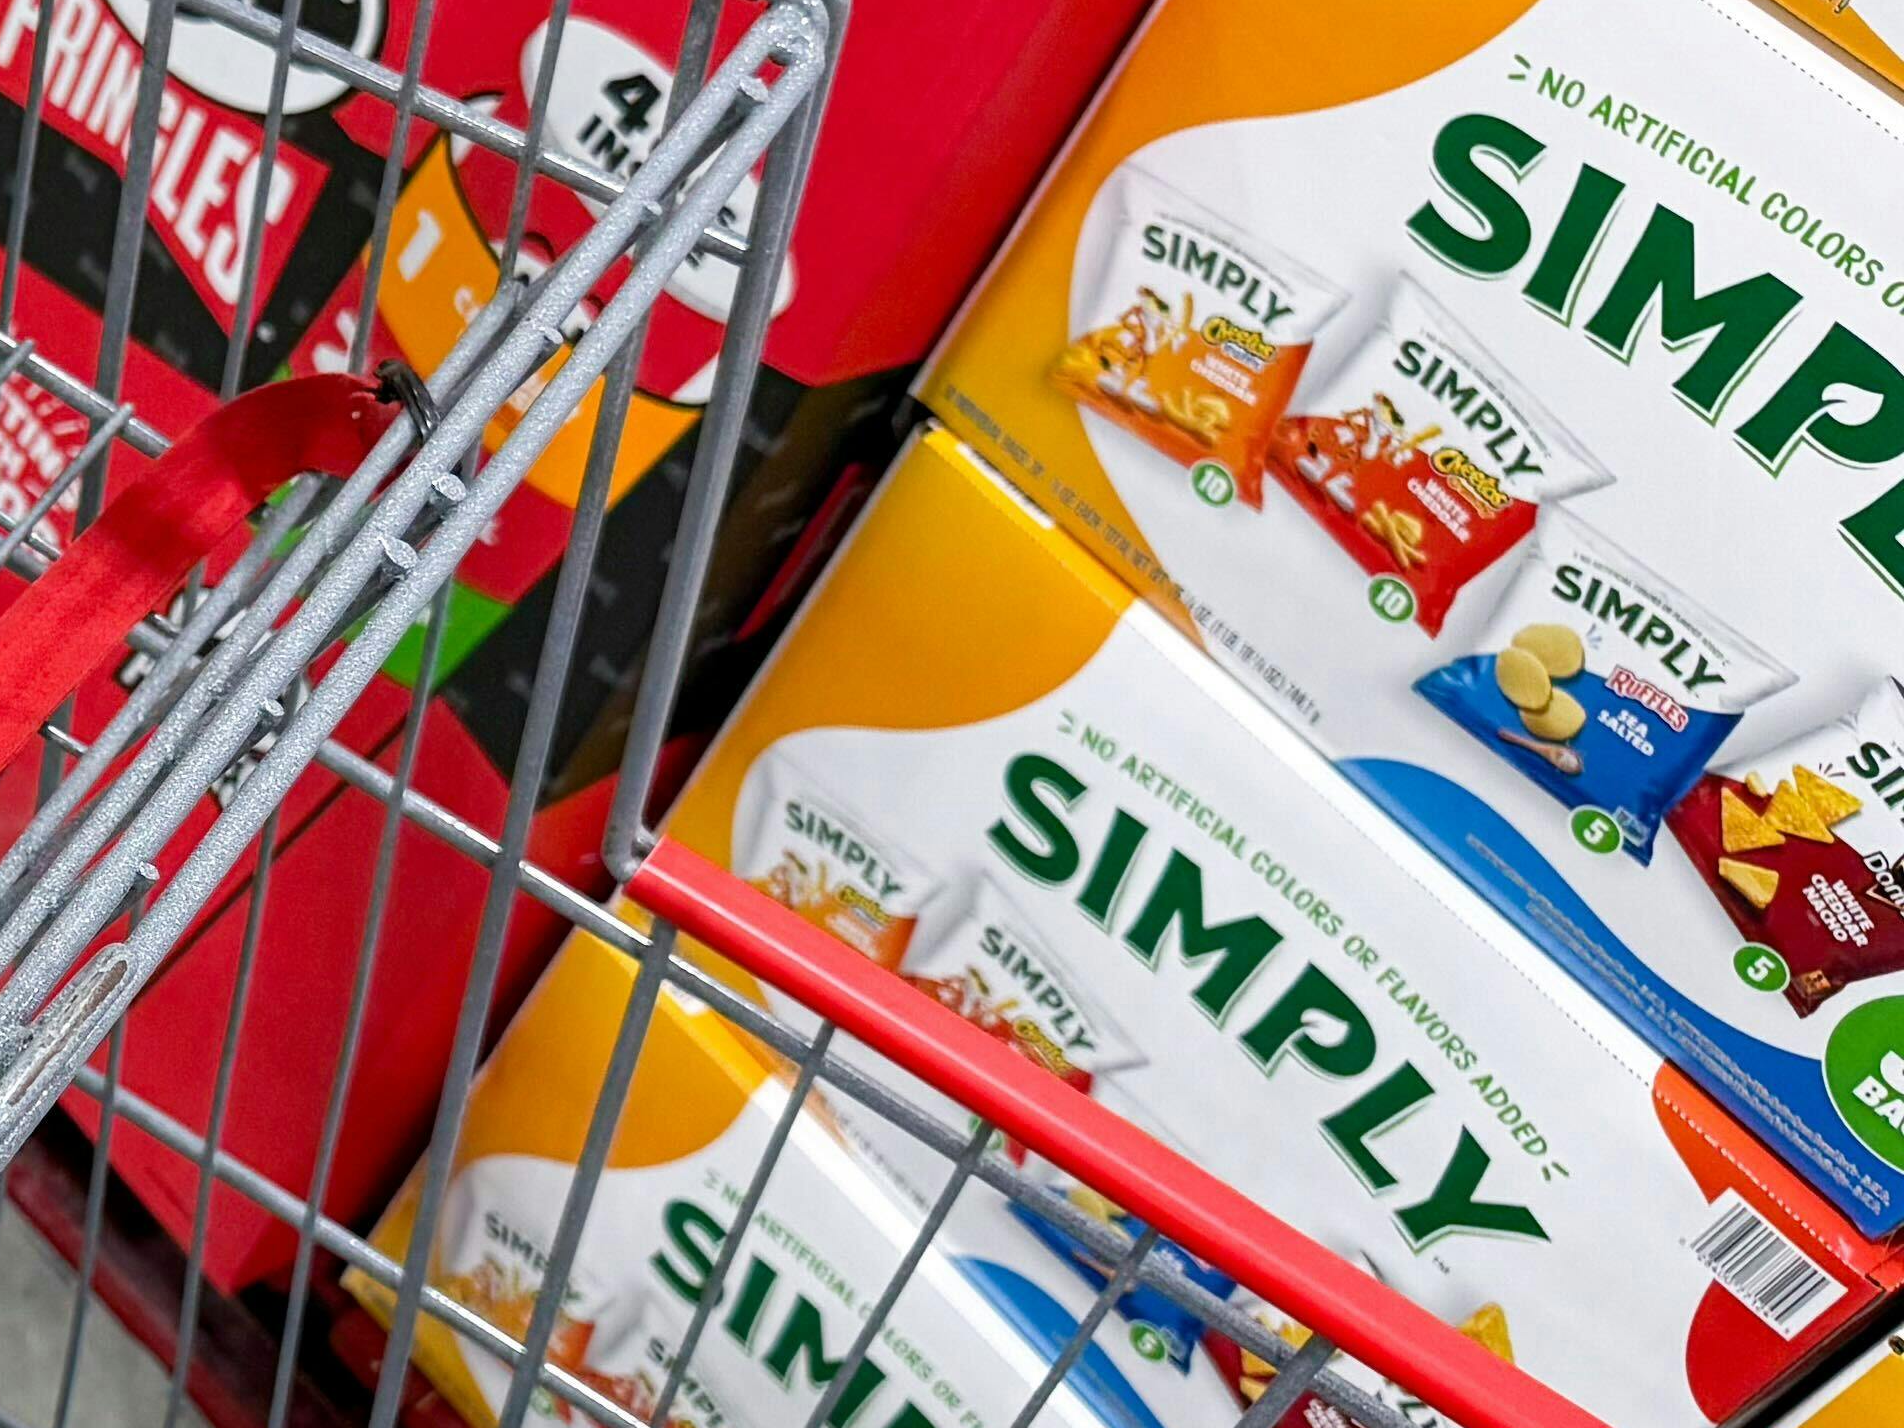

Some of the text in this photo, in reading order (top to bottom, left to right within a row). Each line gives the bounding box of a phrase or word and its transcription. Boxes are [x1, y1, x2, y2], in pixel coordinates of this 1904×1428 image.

[605, 74, 663, 137] 4
[578, 116, 630, 172] IN
[1537, 66, 1885, 289] NO ARTIFICIAL COLORS
[396, 209, 443, 282] 1
[1141, 223, 1296, 324] SIMPLY
[1393, 339, 1544, 486] SIMPLY
[1197, 471, 1226, 501] 10
[1430, 447, 1511, 509] Cheetos
[1377, 584, 1406, 612] 10
[1551, 563, 1727, 696] SIMPLY
[1605, 664, 1690, 733] RUFFLES
[1616, 708, 1650, 740] SEA
[1596, 709, 1655, 758] SALTED
[785, 801, 904, 900] SIMPLY
[1582, 818, 1612, 844] 5
[1802, 885, 1848, 942] NACHO
[1811, 873, 1868, 948] CHEDDAR
[1833, 879, 1875, 932] WHITE
[1079, 724, 1550, 1160] NO ARTIFICIAL COLORS OR FLAVORS ADDED
[1745, 956, 1777, 983] 5
[978, 924, 1096, 1054] SIMPLY
[985, 751, 1552, 1254] SIMPLY
